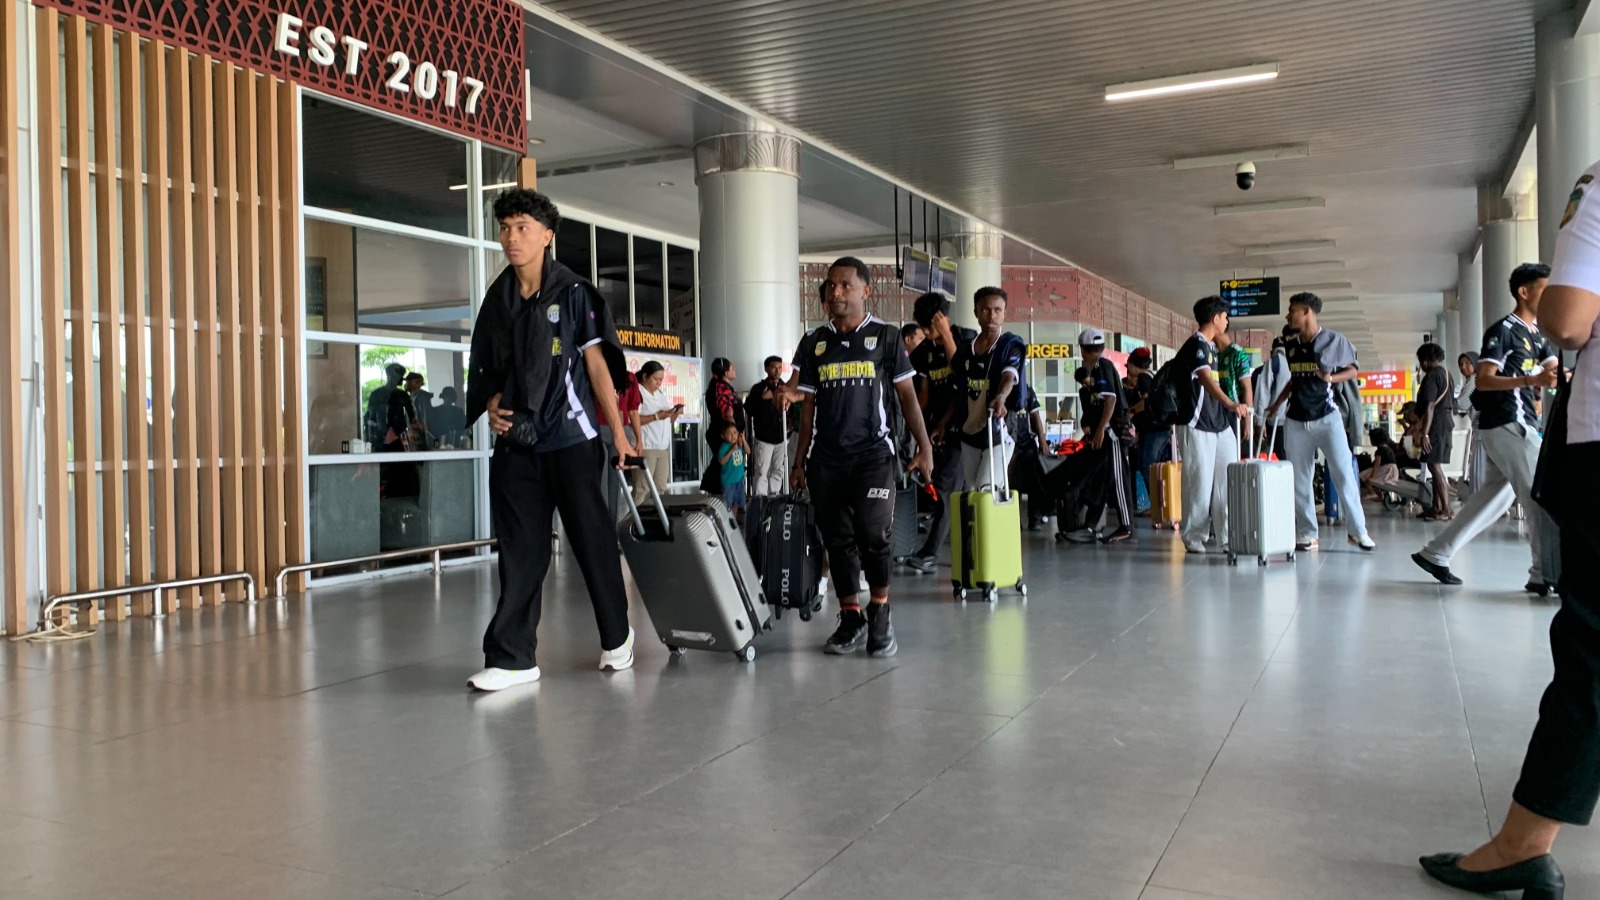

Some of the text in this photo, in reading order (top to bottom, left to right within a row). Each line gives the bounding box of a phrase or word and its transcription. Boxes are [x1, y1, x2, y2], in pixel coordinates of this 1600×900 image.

[274, 12, 484, 114] EST 2017
[634, 331, 680, 350] INFORMATION
[782, 503, 794, 541] POLO
[781, 568, 790, 605] POLO
